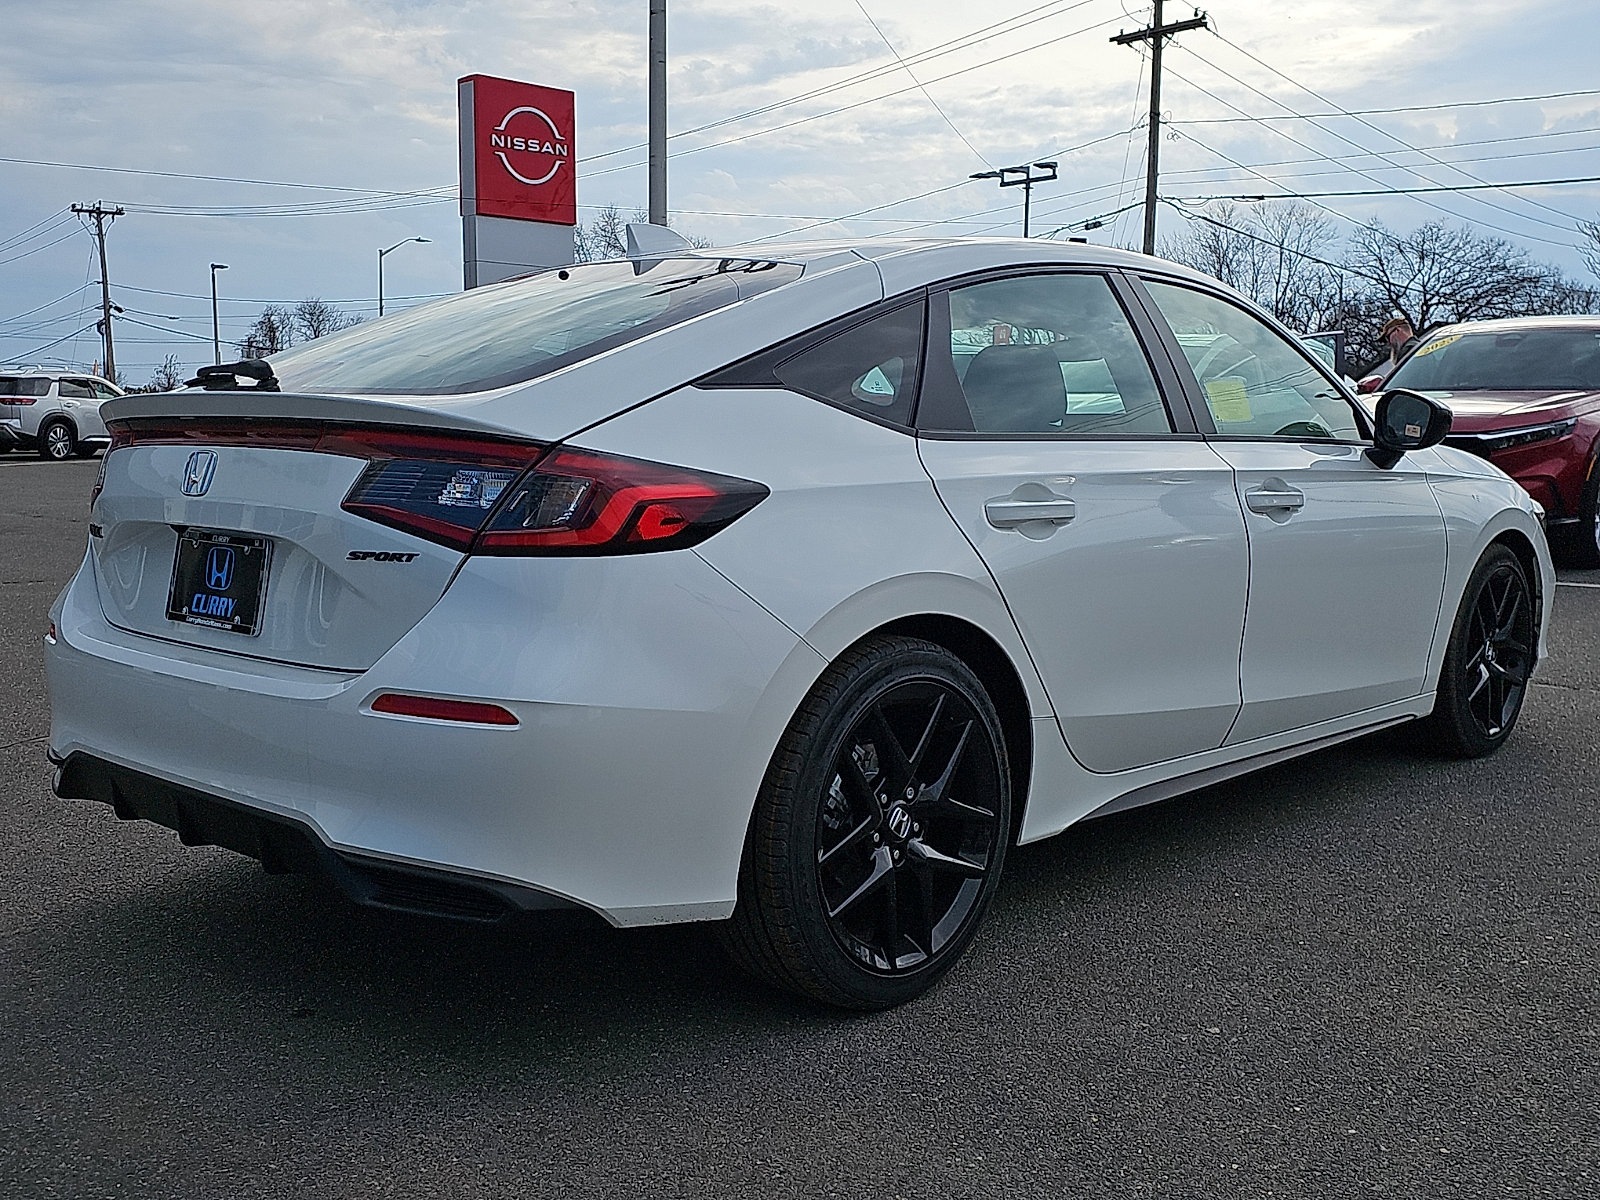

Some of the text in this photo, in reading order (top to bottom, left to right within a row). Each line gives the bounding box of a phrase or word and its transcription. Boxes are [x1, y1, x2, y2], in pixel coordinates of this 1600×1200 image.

[491, 133, 568, 157] NISSAN
[345, 550, 421, 563] SPORT
[191, 594, 237, 617] CURRY
